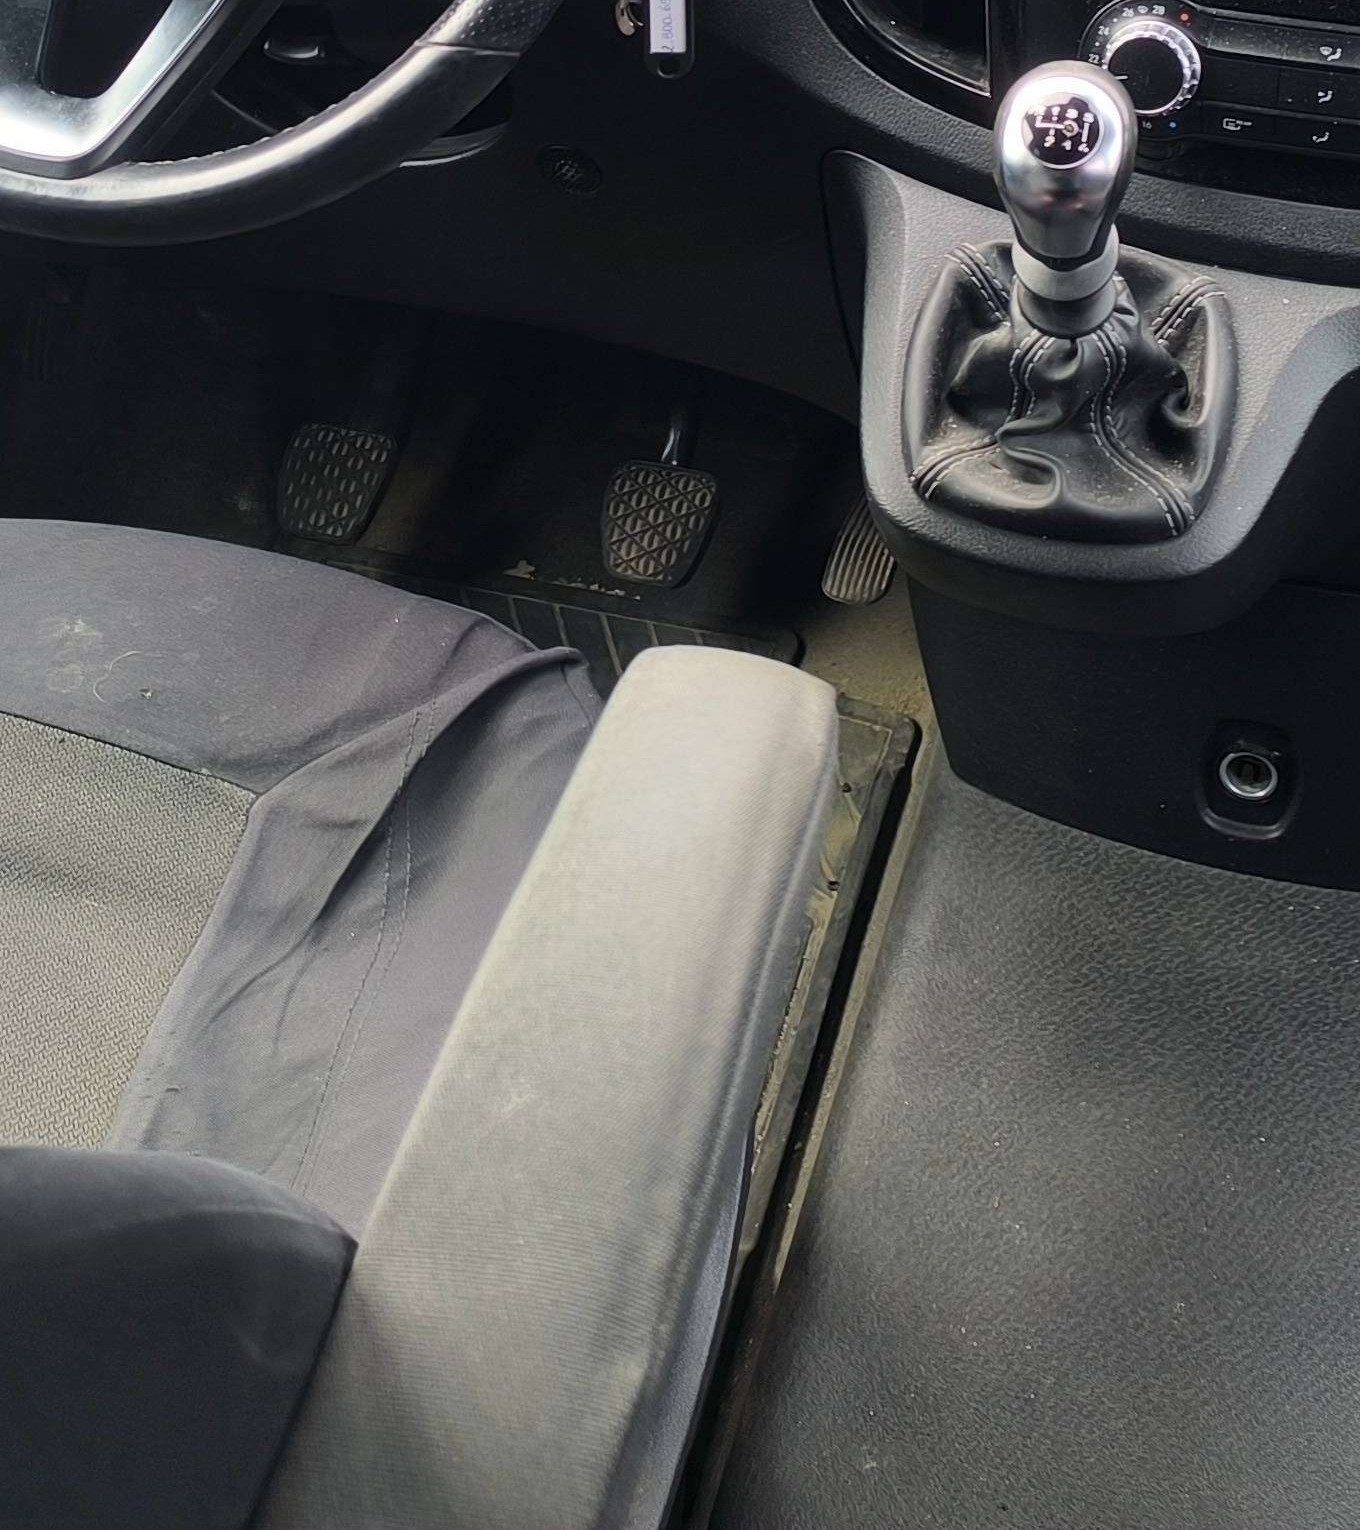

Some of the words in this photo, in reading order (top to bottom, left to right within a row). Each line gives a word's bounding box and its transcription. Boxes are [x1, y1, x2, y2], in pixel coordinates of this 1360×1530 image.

[1122, 7, 1135, 17] 26
[1151, 5, 1166, 15] 28
[1098, 26, 1110, 36] 24
[1088, 54, 1099, 64] 22
